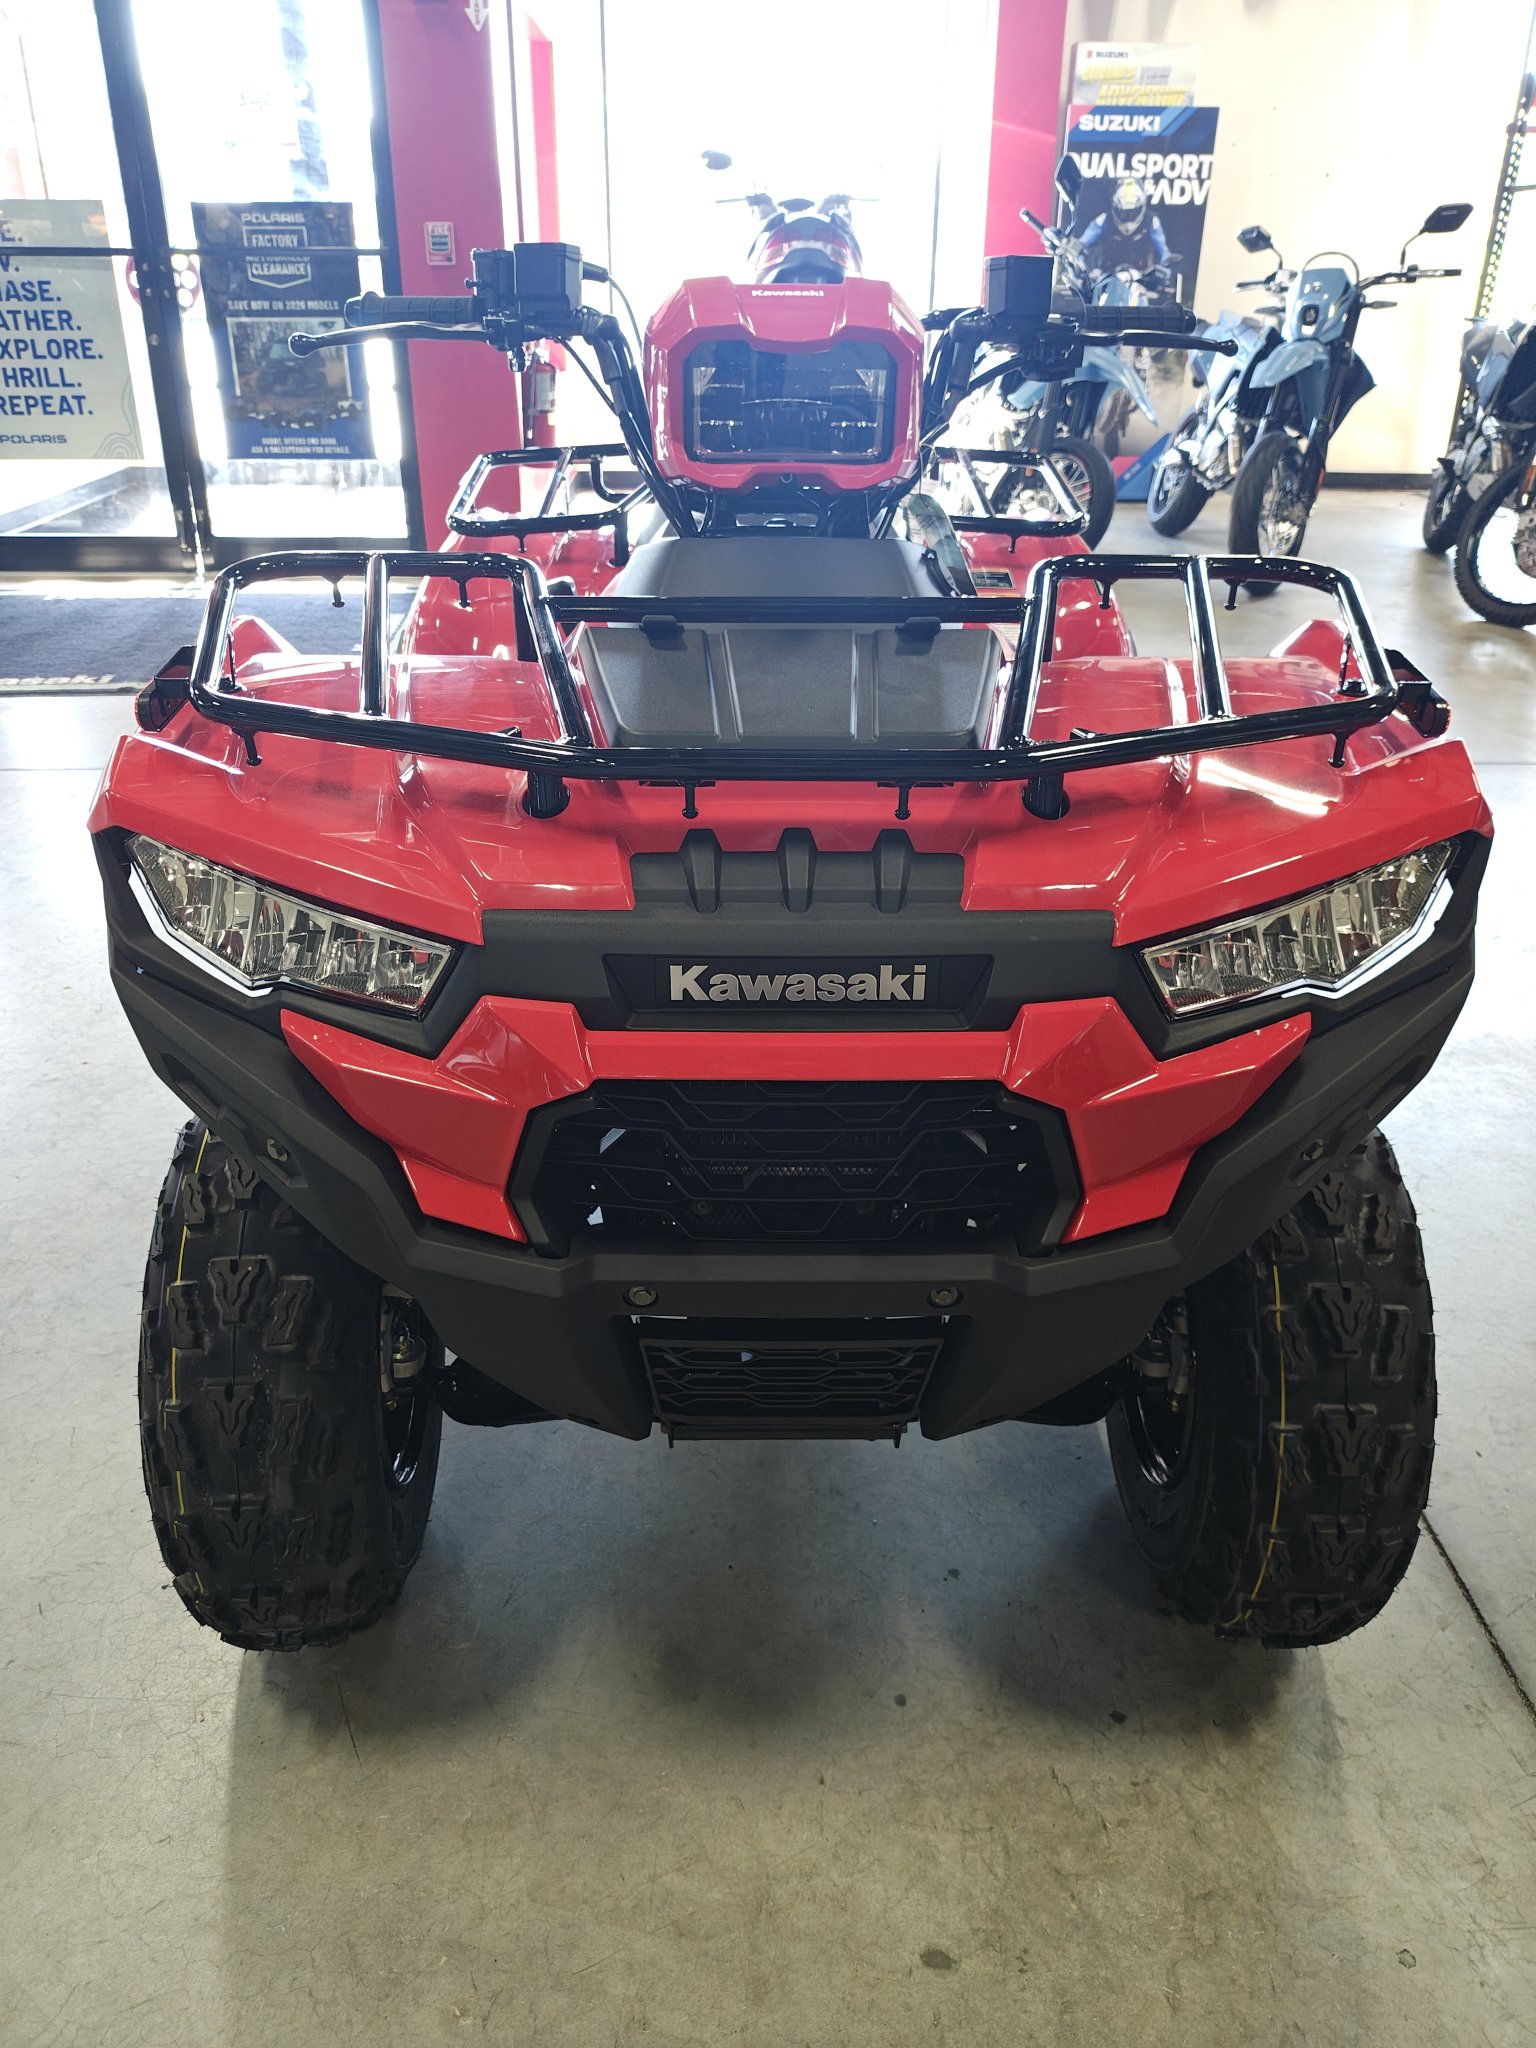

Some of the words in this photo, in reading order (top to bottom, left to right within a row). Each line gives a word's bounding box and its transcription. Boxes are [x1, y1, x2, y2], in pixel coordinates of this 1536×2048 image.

[1078, 114, 1161, 132] SUZUKI
[240, 213, 306, 224] POLARIS
[251, 233, 299, 248] FACTORY
[251, 262, 307, 275] CLEARANCE
[0, 280, 62, 302] ASE.
[751, 289, 825, 297] Kawasaki
[0, 434, 67, 444] POLARIS
[669, 964, 927, 1002] Kawasaki
